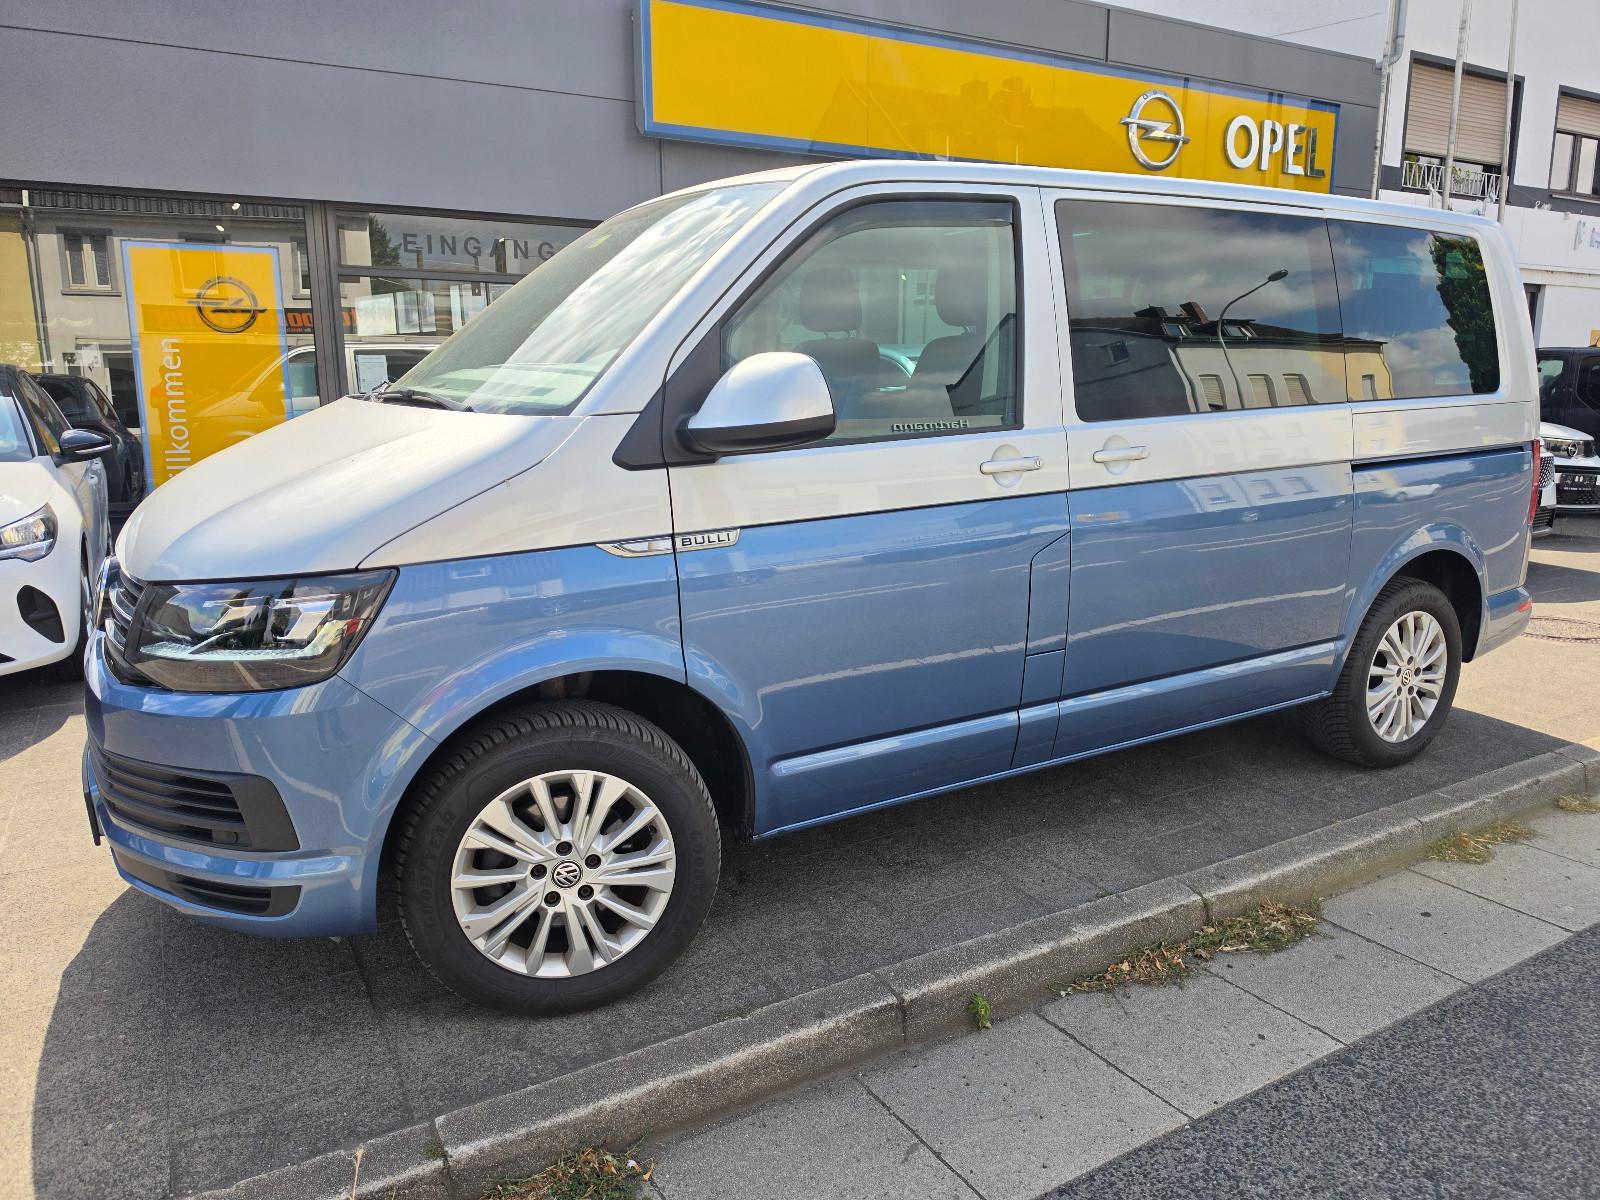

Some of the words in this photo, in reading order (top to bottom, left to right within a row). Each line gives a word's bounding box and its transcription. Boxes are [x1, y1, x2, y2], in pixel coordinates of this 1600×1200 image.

[1225, 115, 1325, 177] OPEL
[402, 232, 556, 261] EINGANG
[161, 337, 191, 477] llkommen
[681, 533, 731, 547] BULLI
